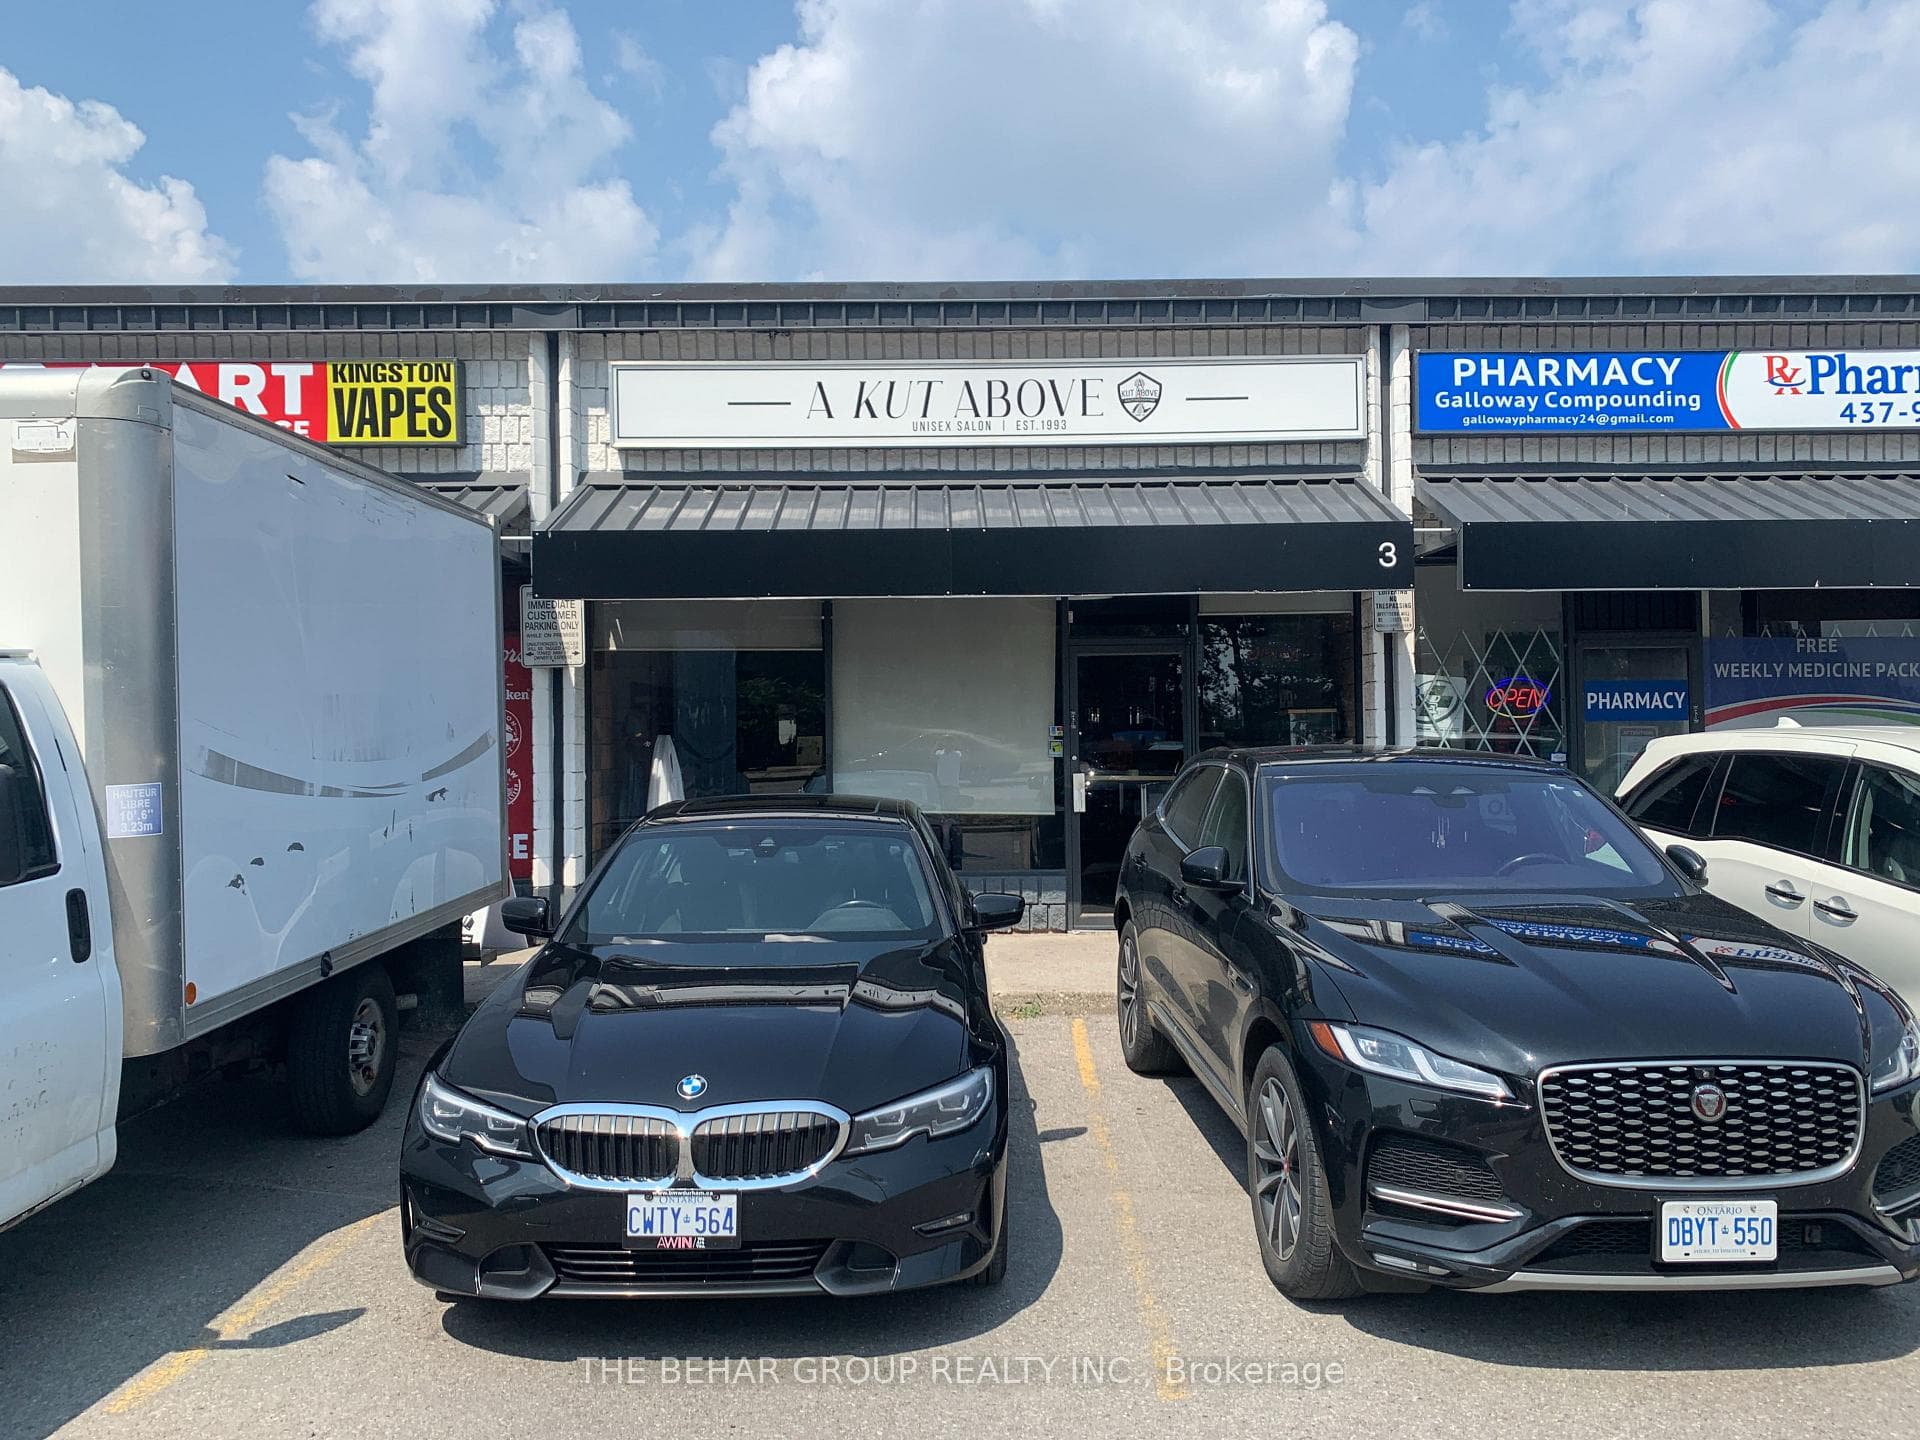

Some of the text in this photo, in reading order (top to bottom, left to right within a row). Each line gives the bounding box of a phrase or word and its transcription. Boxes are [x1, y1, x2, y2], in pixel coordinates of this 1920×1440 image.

[332, 363, 451, 383] KINGSTON
[1453, 357, 1682, 387] PHARMACY
[1805, 353, 1920, 395] Phar
[806, 378, 1104, 419] A KUT ABOVE
[1435, 390, 1701, 412] Galloway Compounding
[334, 386, 452, 438] VAPES
[1463, 413, 1675, 427] gallowaypharmacy24@gmail.com
[912, 419, 1067, 432] UNISEX SALON EST.1993
[1379, 542, 1397, 567] 3
[527, 600, 576, 609] IMMEDIATE
[527, 611, 577, 620] CUSTOMER
[525, 622, 578, 631] PARKING ONLY
[1796, 638, 1838, 653] FREE
[1714, 663, 1784, 678] WEEKLY
[1788, 662, 1871, 678] MEDICINE
[1489, 688, 1544, 708] OPEN
[1587, 691, 1686, 709] PHARMACY
[112, 788, 157, 799] HAUTEUR
[120, 799, 151, 809] LIBRE
[121, 821, 153, 833] 3.23m
[1697, 1206, 1743, 1216] ONTARIO
[628, 1207, 734, 1234] CWTY 564
[1668, 1217, 1773, 1246] DBYT 550
